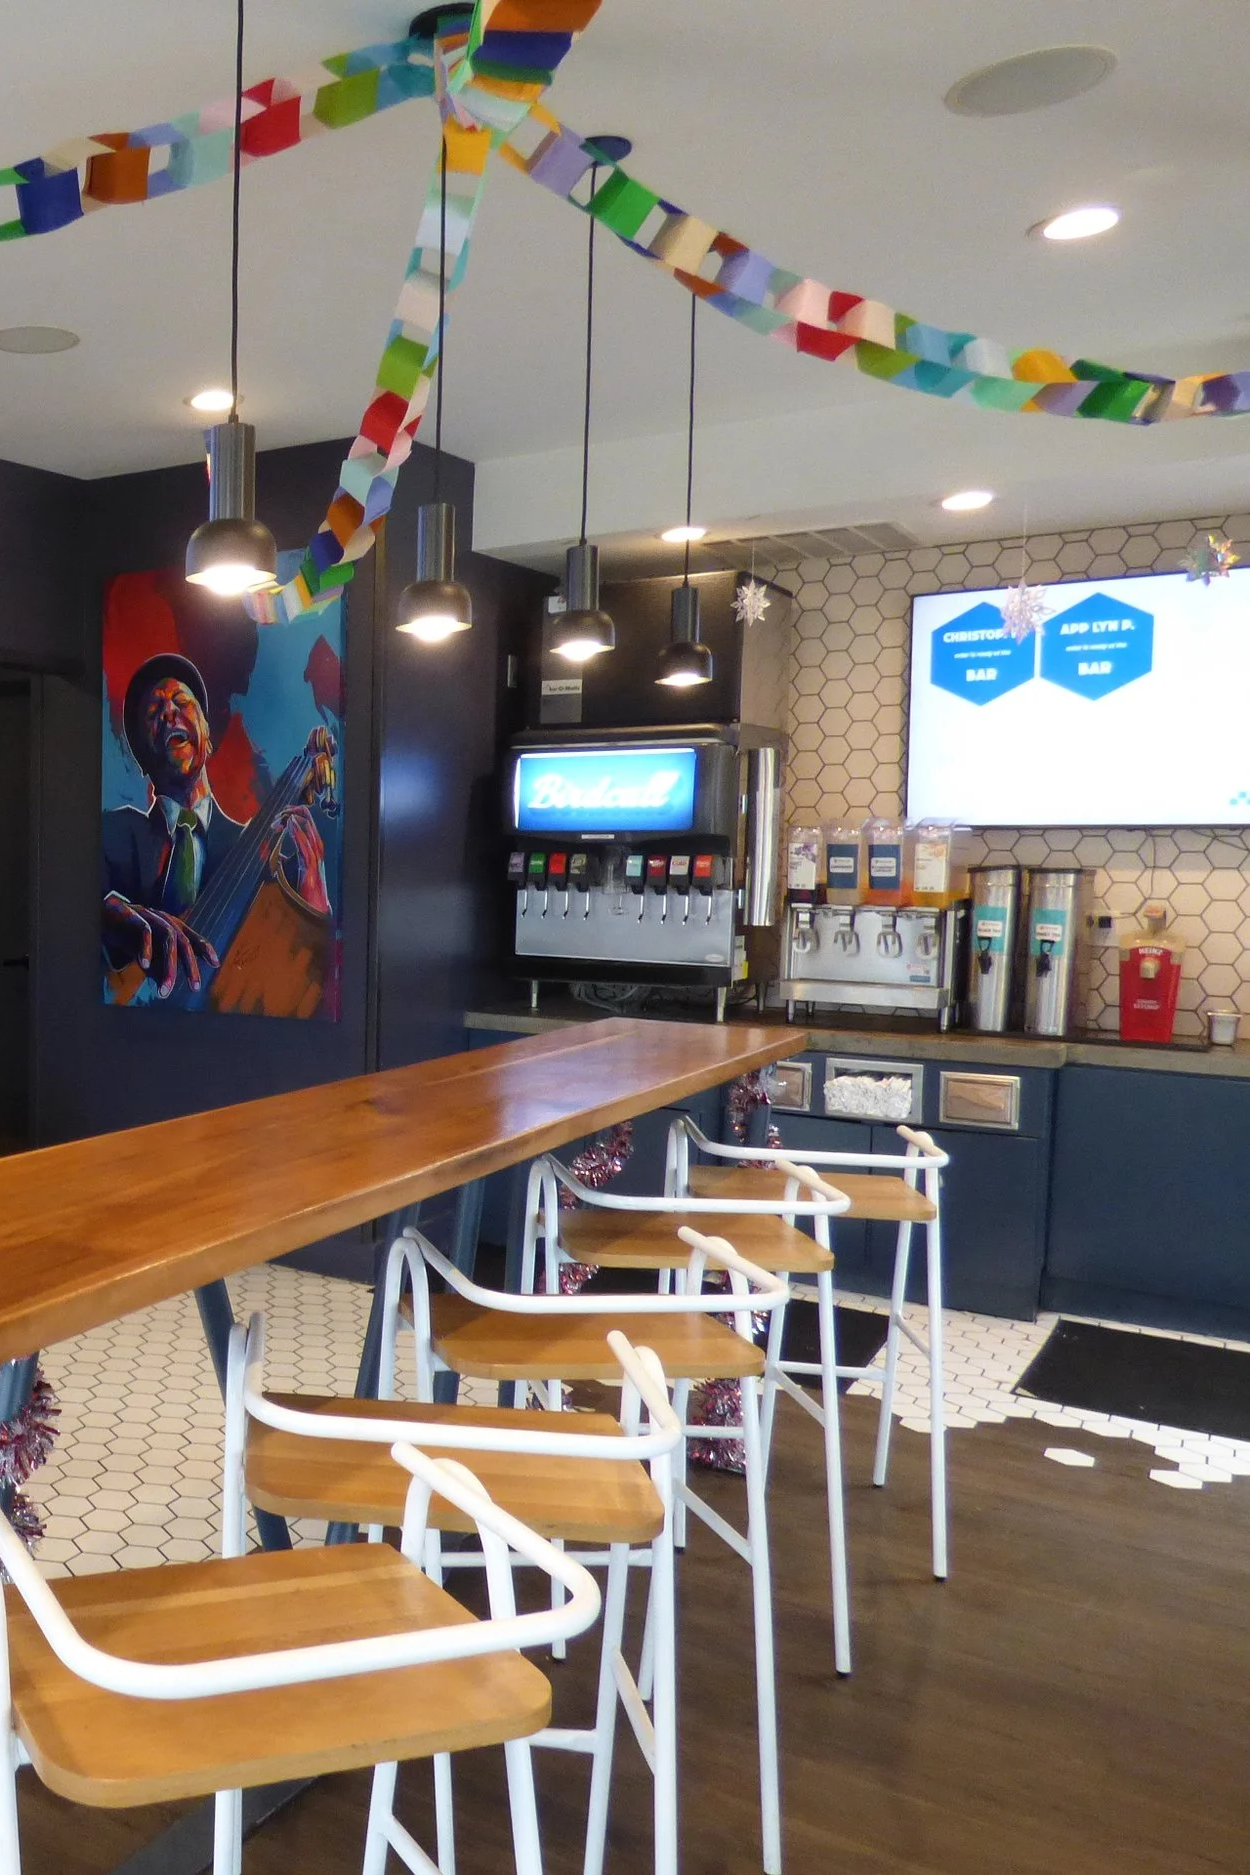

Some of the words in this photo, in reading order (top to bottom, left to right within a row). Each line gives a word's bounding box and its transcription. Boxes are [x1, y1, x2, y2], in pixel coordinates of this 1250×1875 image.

[966, 668, 998, 682] BAR
[1078, 661, 1112, 676] BAR
[528, 771, 680, 809] Birdcall
